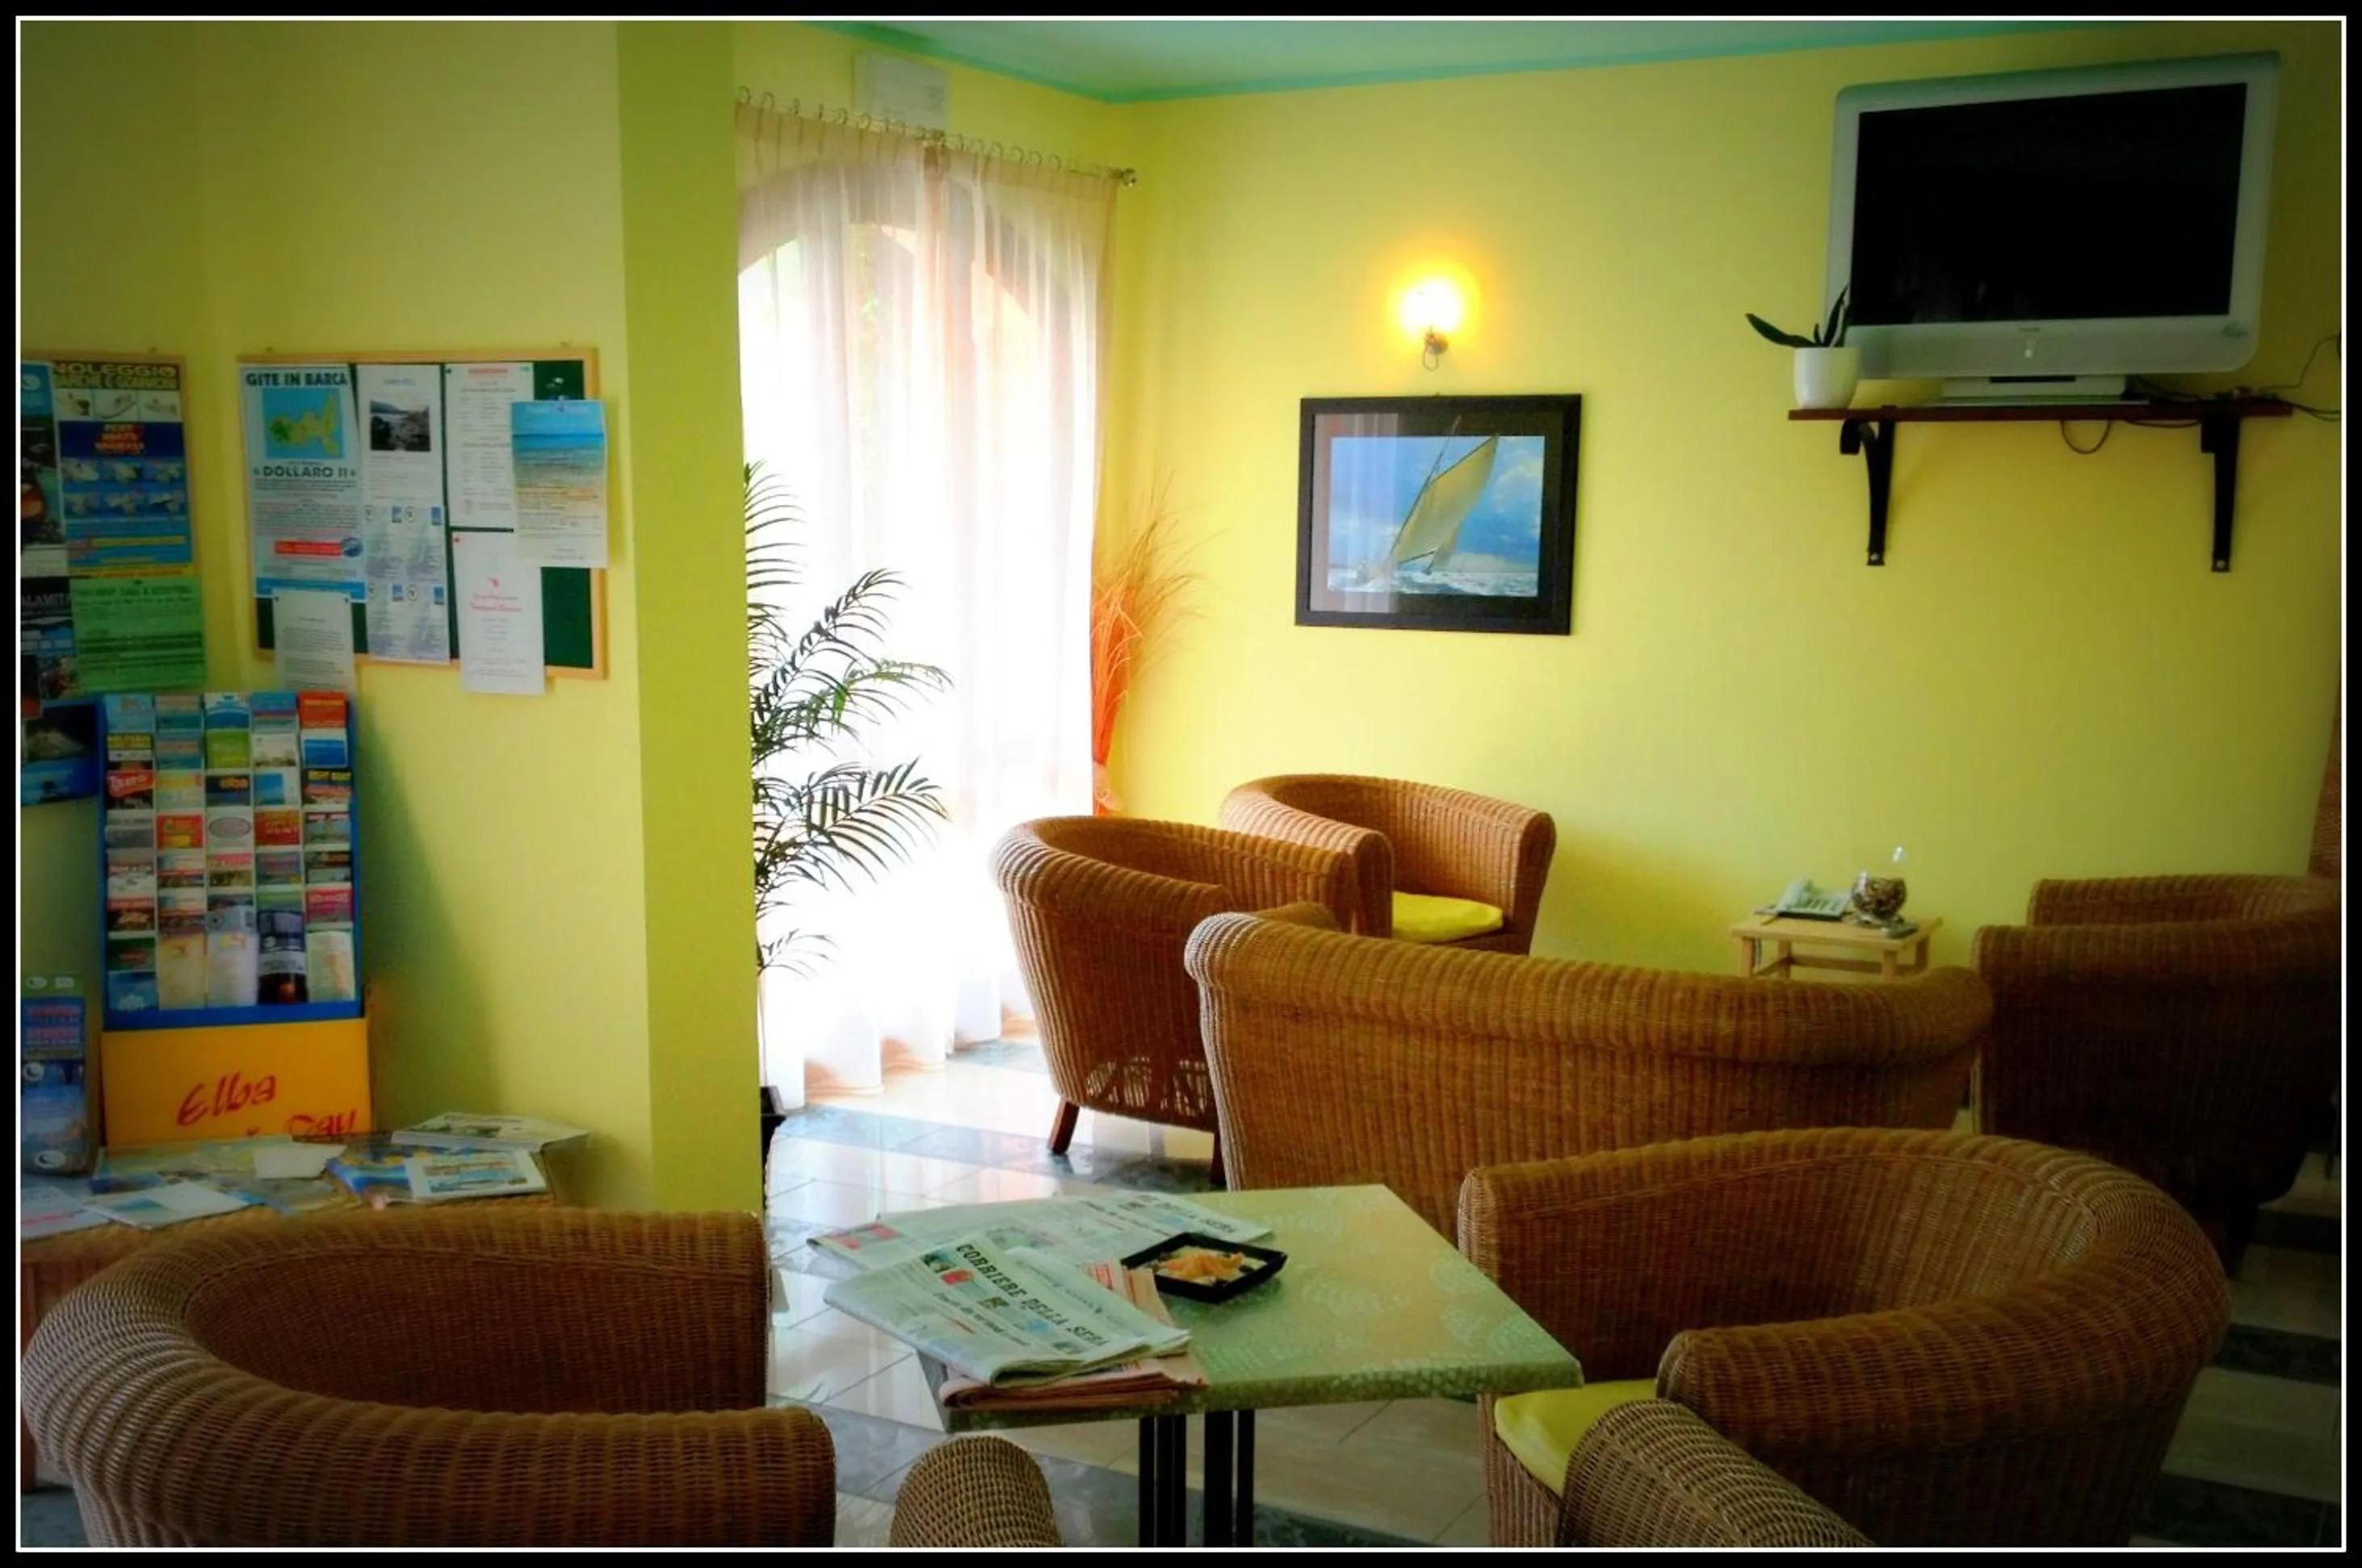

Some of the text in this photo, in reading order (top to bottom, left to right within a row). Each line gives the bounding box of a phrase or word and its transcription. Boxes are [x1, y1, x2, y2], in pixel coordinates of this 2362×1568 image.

[246, 373, 348, 386] GITE IN BARCA
[262, 465, 334, 477] DOLLARO
[177, 1071, 276, 1126] Elba
[957, 1243, 1027, 1298] CORRIERE
[1021, 1298, 1070, 1325] DELLA
[1066, 1326, 1110, 1346] SERA
